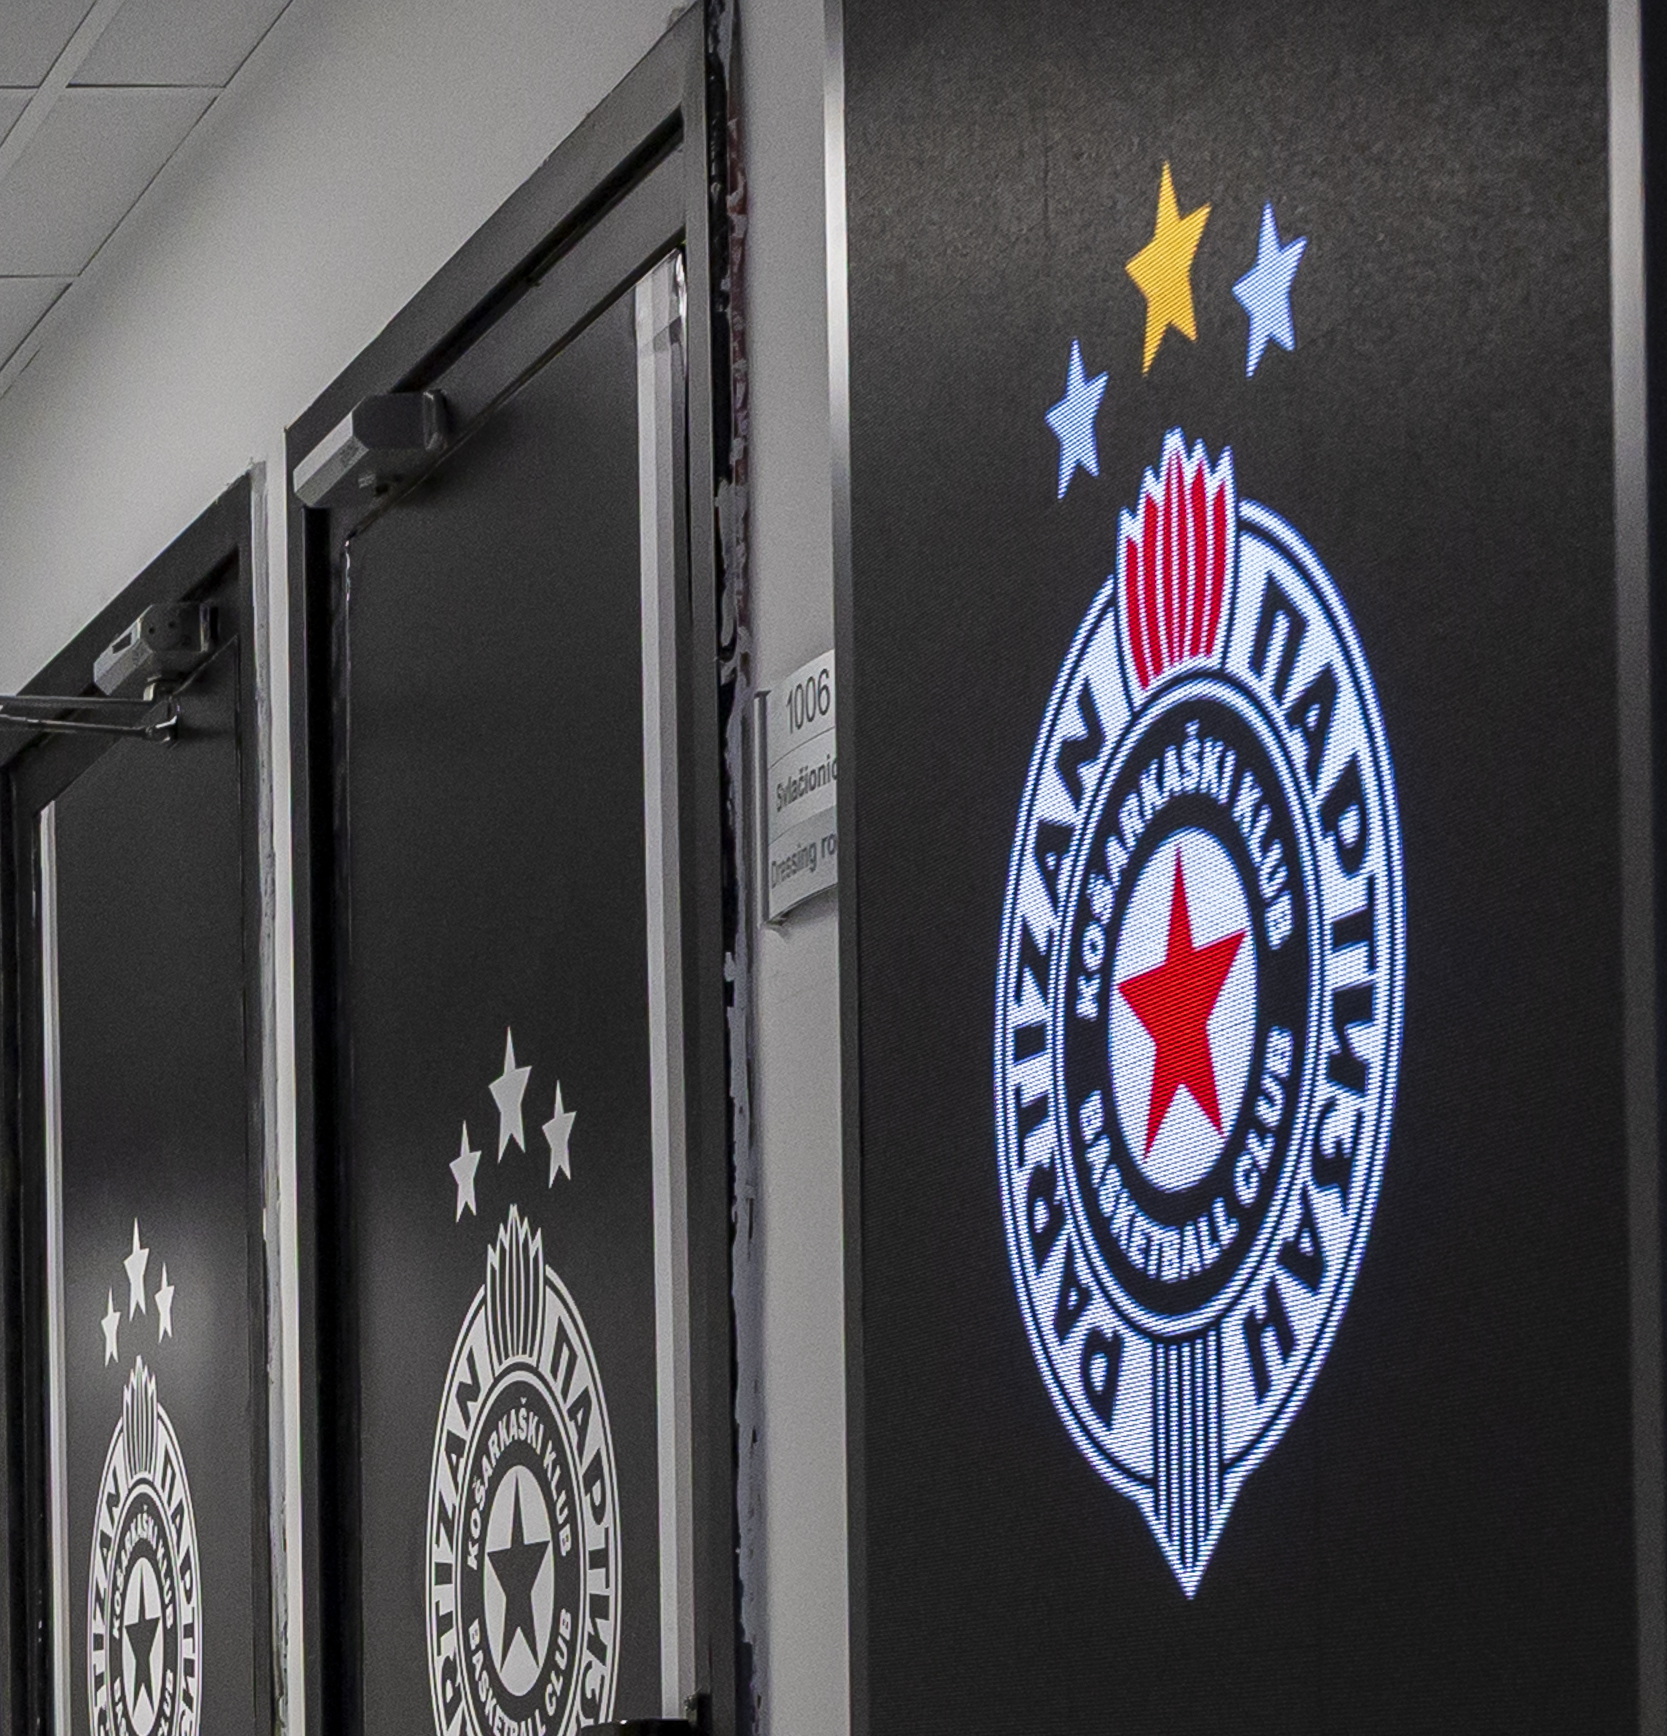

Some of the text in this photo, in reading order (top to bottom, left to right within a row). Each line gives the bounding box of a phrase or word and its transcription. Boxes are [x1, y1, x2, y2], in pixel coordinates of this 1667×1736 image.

[785, 668, 831, 734] 1006
[771, 842, 817, 889] Dressing
[1075, 719, 1294, 1021] KOŠARKAŠKI KLUB
[1013, 675, 1124, 1432] PARTIZAN
[1242, 566, 1378, 1404] ПАРТИЗАН
[1079, 1025, 1295, 1283] BASKETBALL CLUB
[467, 1396, 572, 1571] KOŠARKAŠKI KLUB
[156, 1538, 174, 1629] KLUB
[544, 1607, 572, 1717] CLUB
